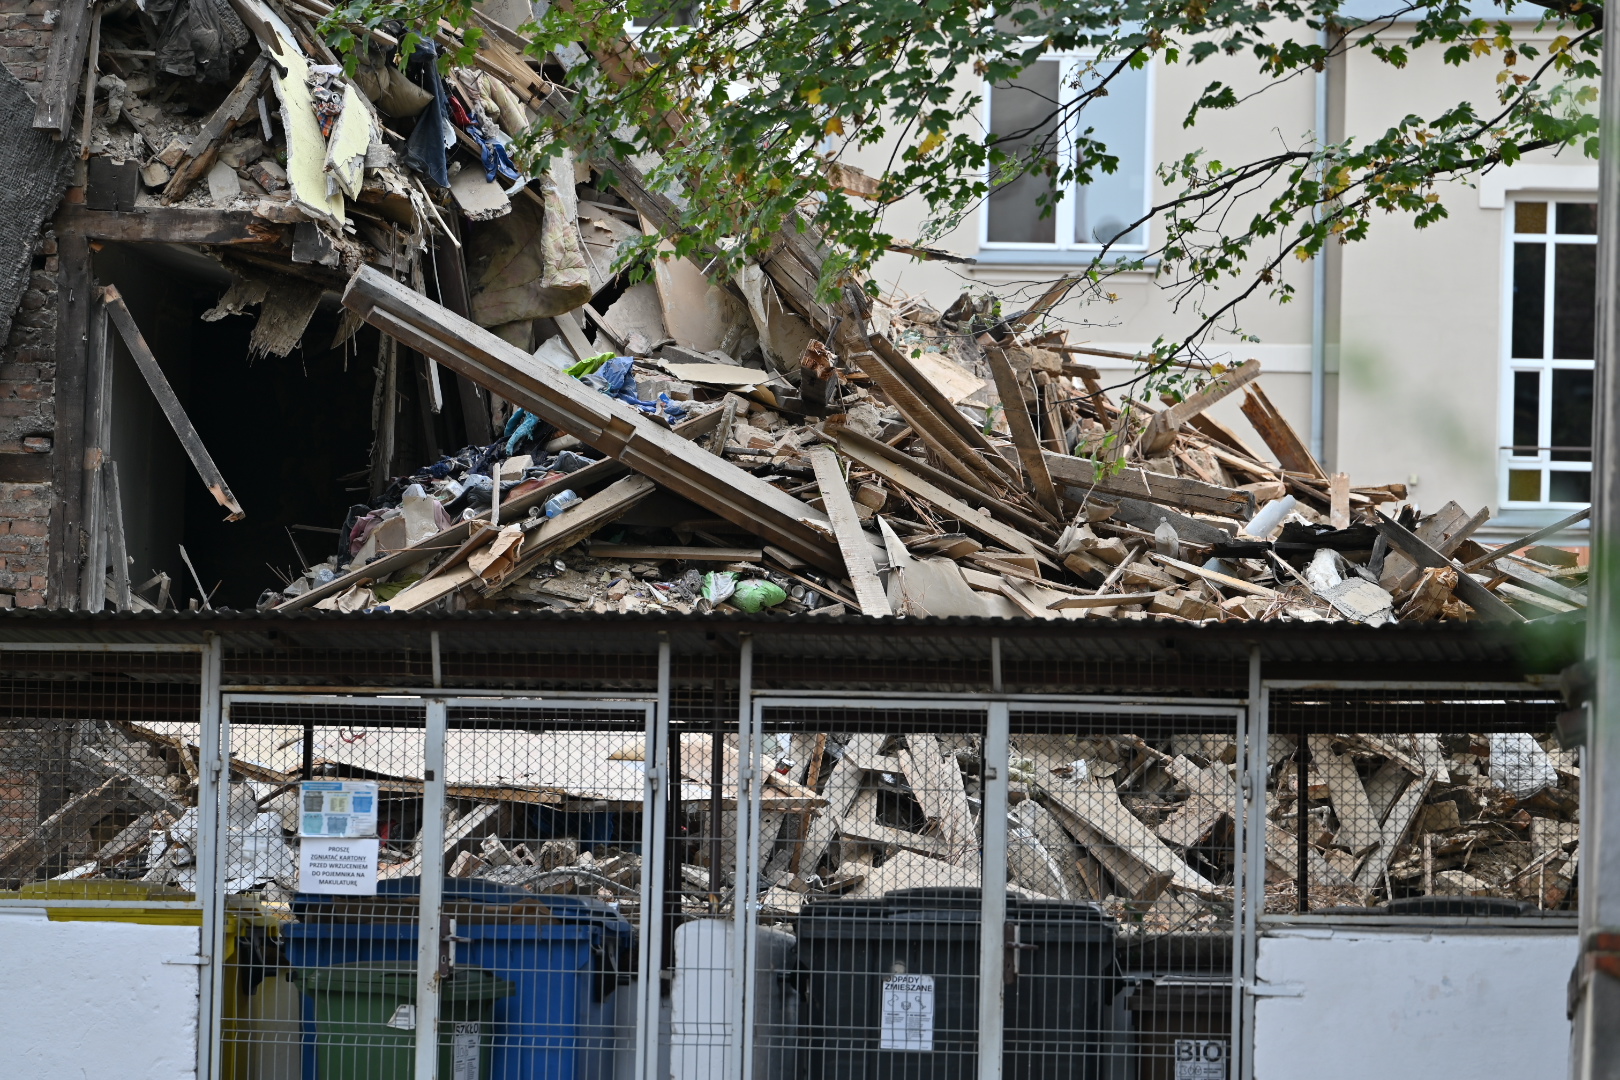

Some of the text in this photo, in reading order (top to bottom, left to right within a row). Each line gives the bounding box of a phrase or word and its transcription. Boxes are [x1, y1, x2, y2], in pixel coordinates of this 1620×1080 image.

[318, 879, 358, 887] MAKULATURĘ
[885, 983, 932, 992] ZMIESZANE
[1176, 1041, 1222, 1063] BIO
